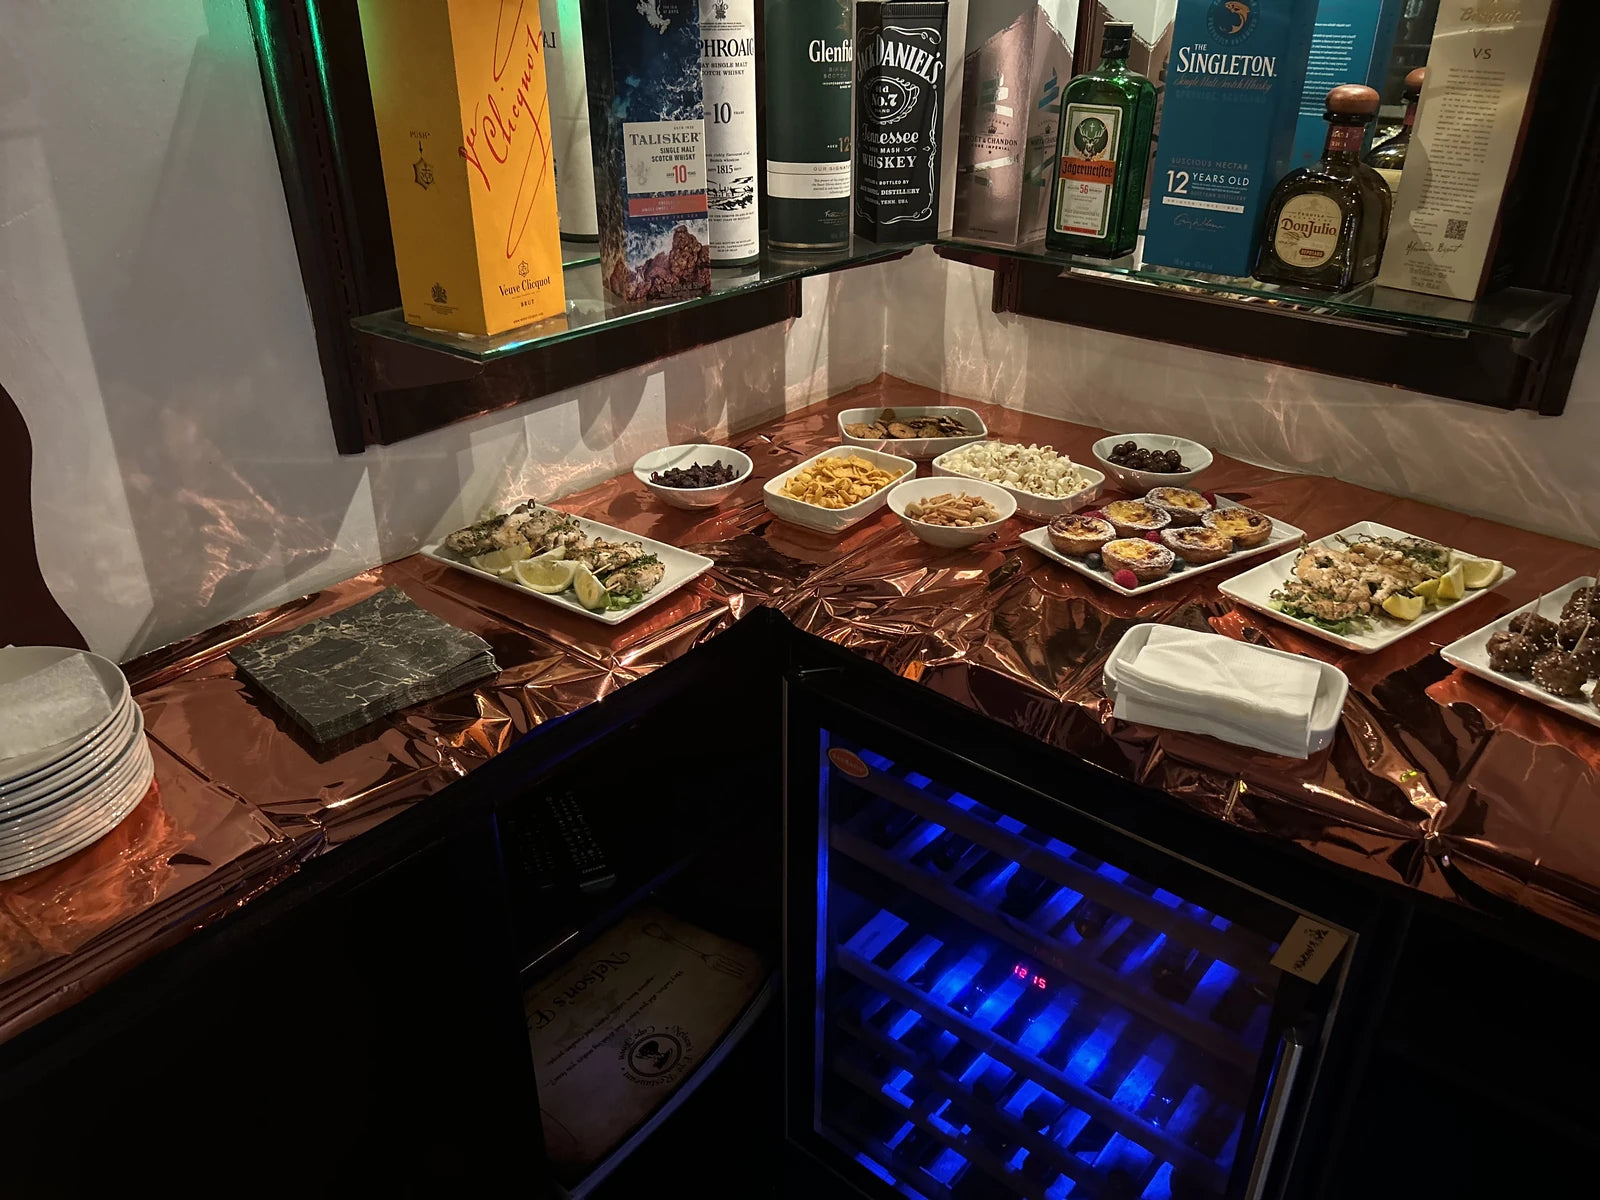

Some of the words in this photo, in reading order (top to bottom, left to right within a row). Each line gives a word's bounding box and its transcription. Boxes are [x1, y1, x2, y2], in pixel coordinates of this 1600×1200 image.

[809, 39, 852, 62] Glenfid
[1473, 48, 1492, 60] VS
[857, 42, 875, 82] JACK
[1177, 47, 1276, 77] SINGLETON
[713, 102, 732, 124] 10
[629, 132, 700, 146] TALISKER
[838, 136, 850, 152] 12
[987, 138, 1018, 146] CHANDON
[863, 153, 917, 168] WHISKEY
[1172, 158, 1212, 167] LUSCIOUS
[1215, 162, 1248, 170] NECTAR
[672, 164, 687, 184] 10
[717, 164, 733, 174] 1815
[1080, 184, 1088, 194] 56
[1167, 170, 1189, 194] 12
[1192, 172, 1224, 184] YEARS
[1228, 176, 1249, 186] OLD
[498, 284, 520, 296] Veuve
[521, 276, 550, 292] Clicquot
[520, 299, 534, 308] BRUT
[1014, 964, 1028, 978] 12
[553, 951, 631, 1008] Nelson's
[1033, 976, 1047, 989] 15
